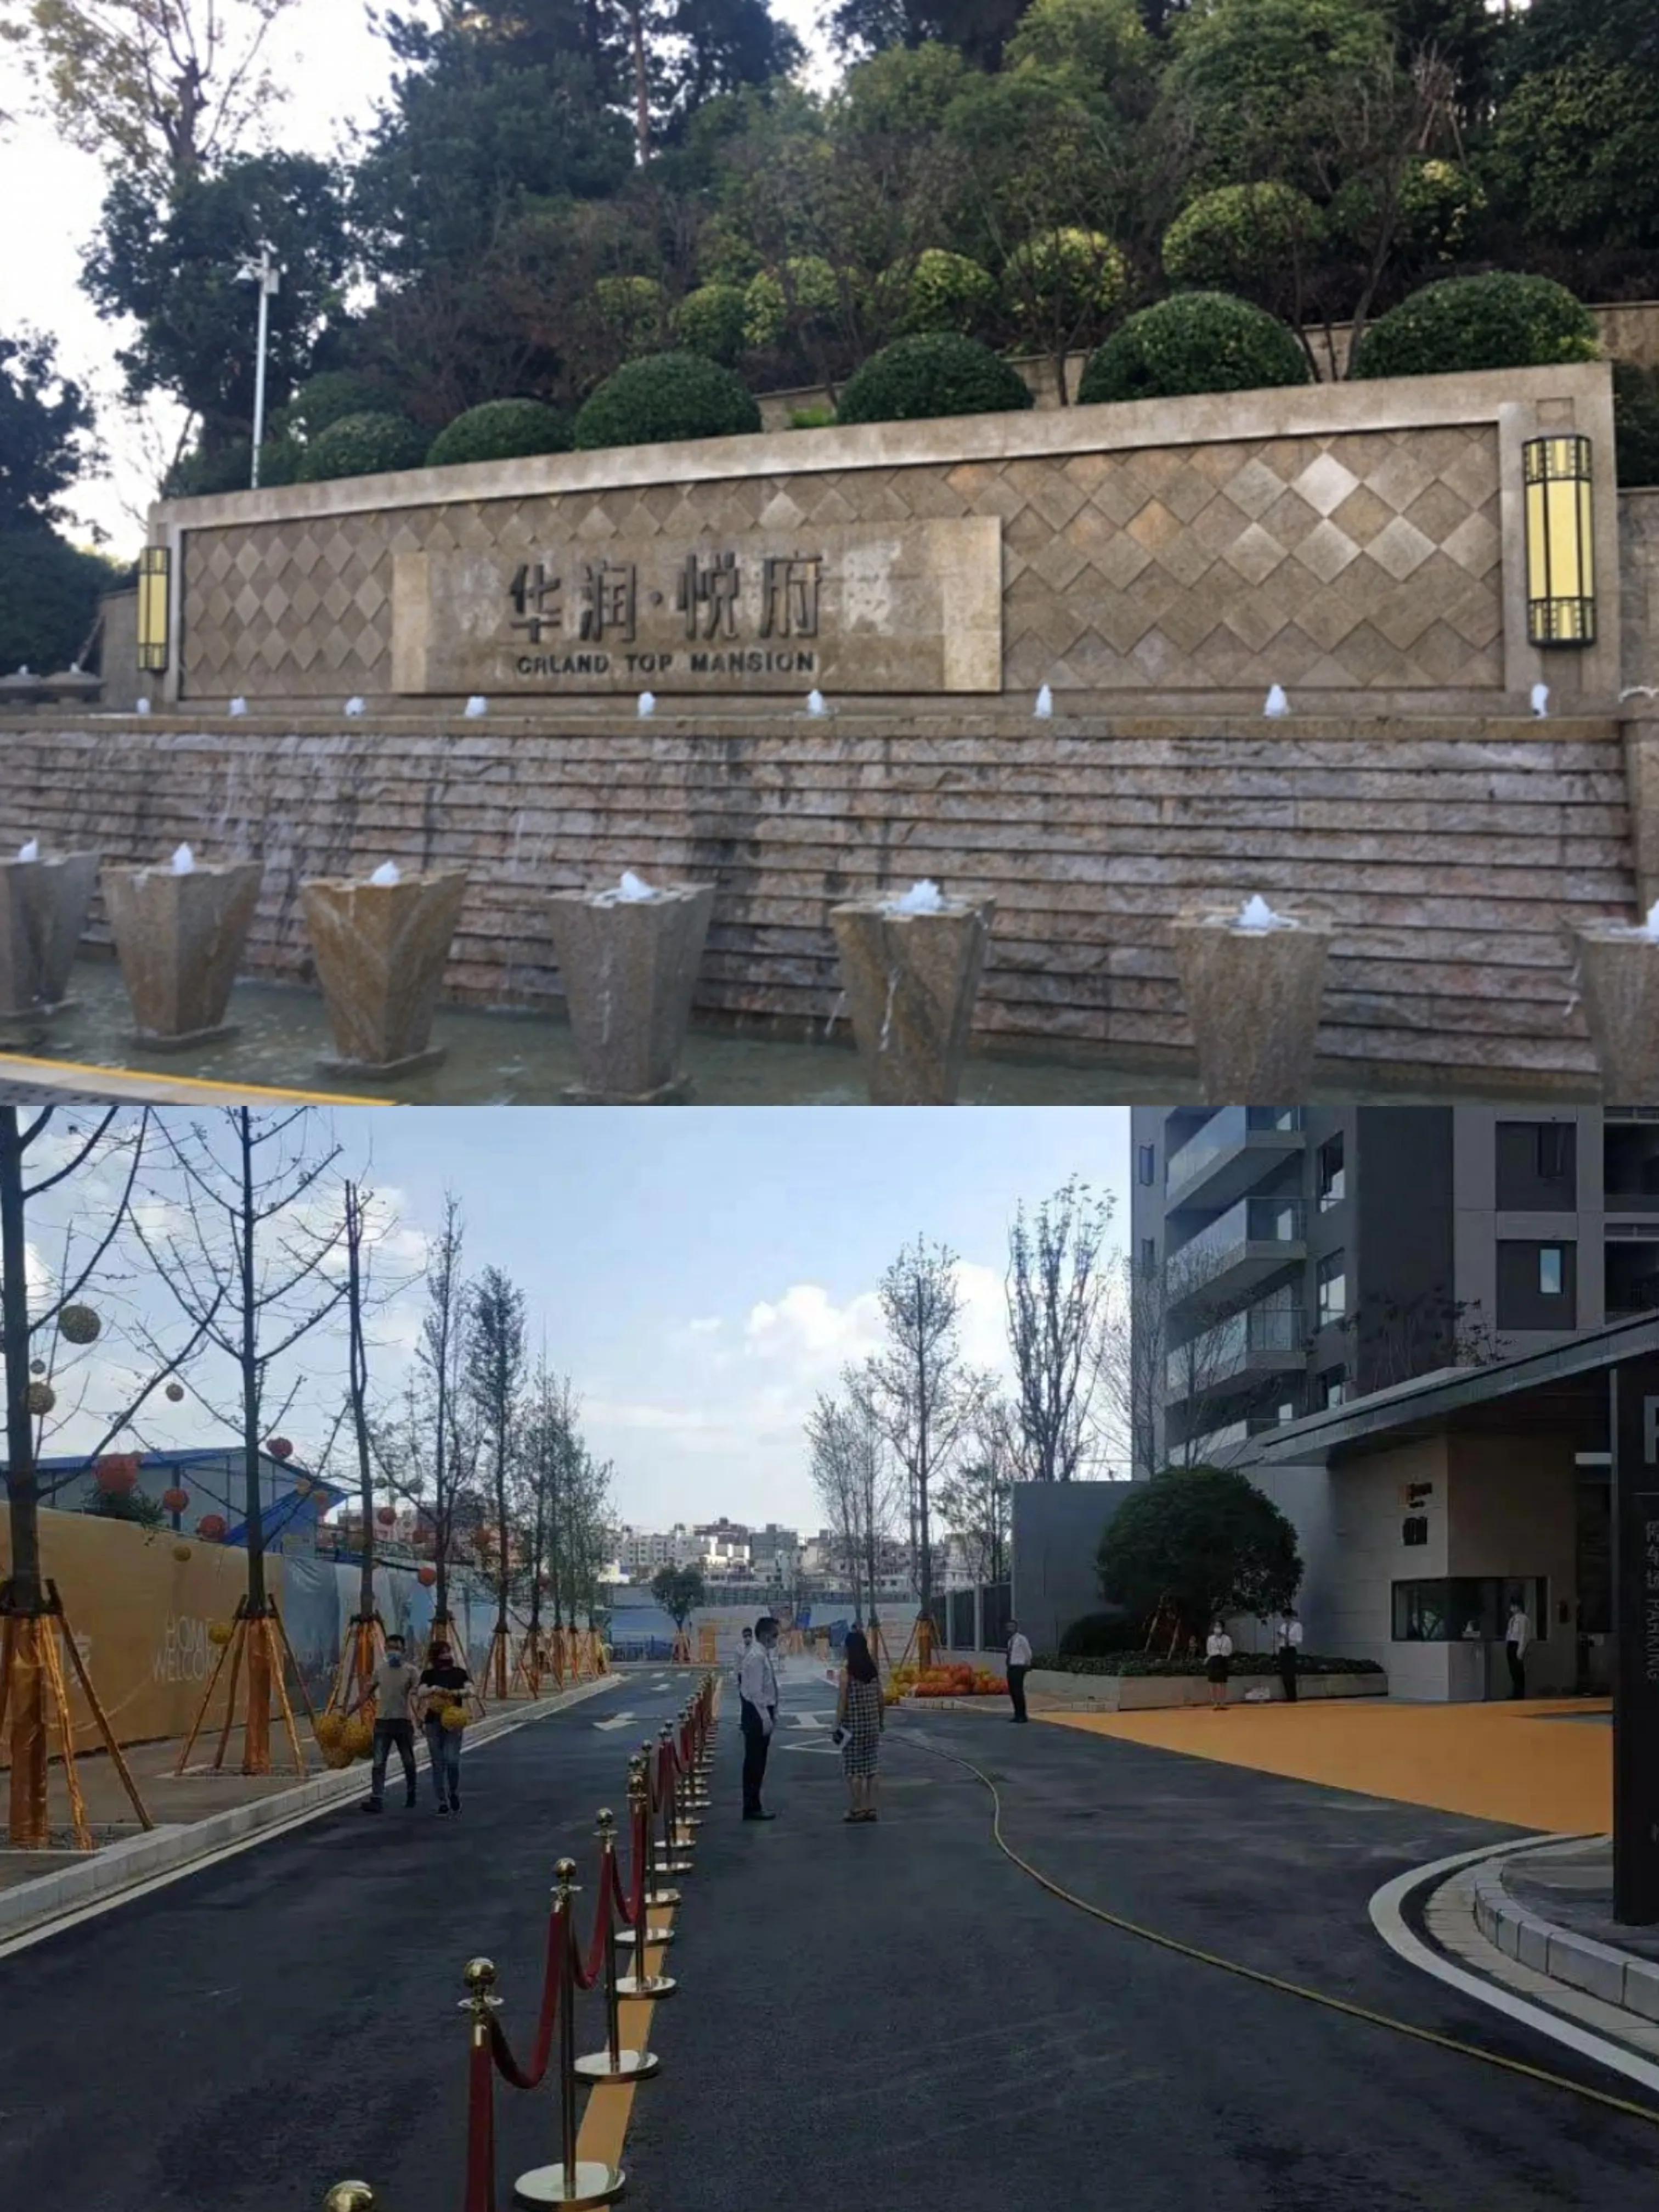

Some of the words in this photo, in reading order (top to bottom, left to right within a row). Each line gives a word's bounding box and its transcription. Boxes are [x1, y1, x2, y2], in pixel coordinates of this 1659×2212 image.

[510, 550, 823, 644] 华润·悦府
[517, 653, 609, 674] CRLAND
[625, 653, 673, 673] TOP
[690, 651, 814, 673] MANSION
